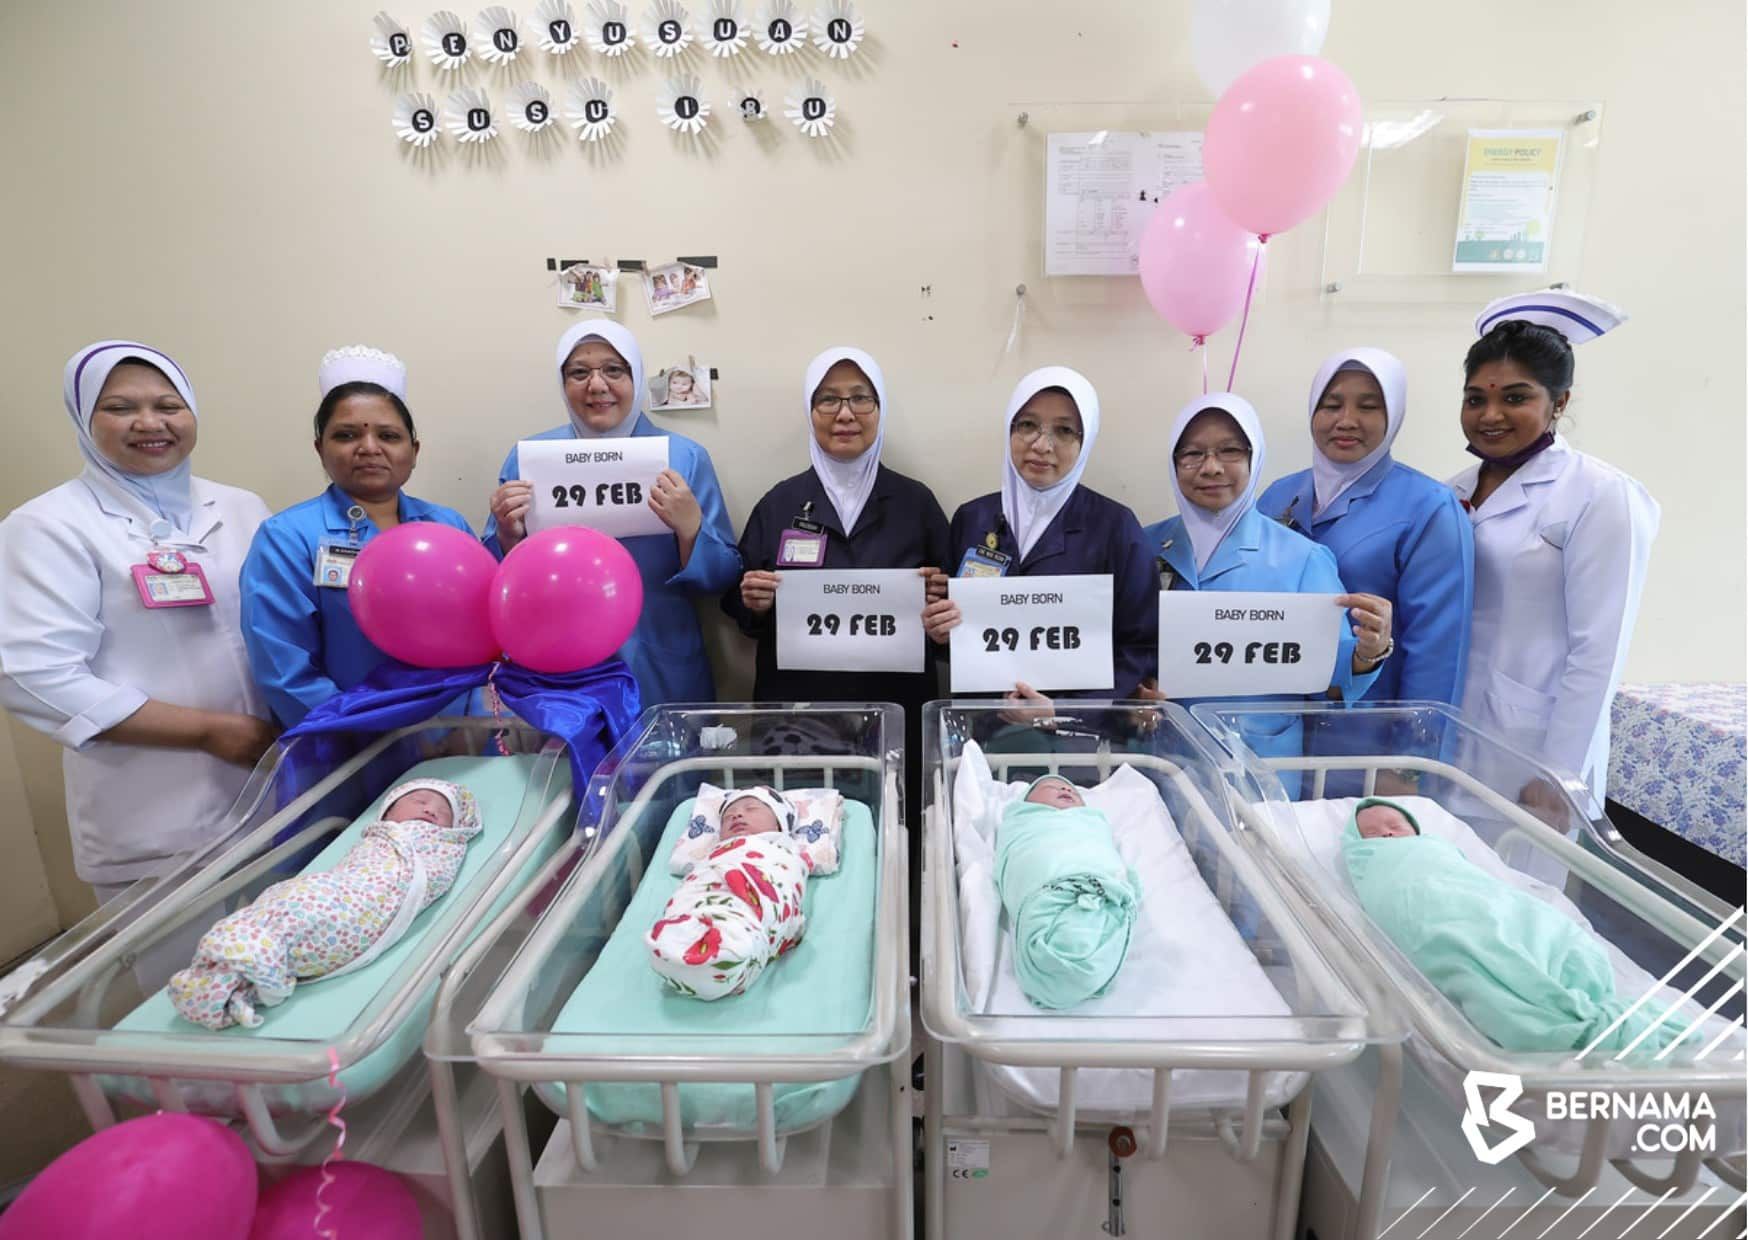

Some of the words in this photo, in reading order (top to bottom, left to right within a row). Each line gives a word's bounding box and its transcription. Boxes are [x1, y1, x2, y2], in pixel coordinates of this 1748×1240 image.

[392, 17, 850, 54] PENYUSUAN
[415, 101, 606, 128] SUSU
[565, 453, 591, 464] BABY
[594, 451, 623, 462] BORN
[552, 484, 586, 508] 29
[595, 482, 643, 506] FEB
[823, 584, 849, 594] BABY
[852, 584, 880, 594] BORN
[1000, 594, 1029, 605] BABY
[1032, 593, 1063, 604] BORN
[806, 613, 841, 636] 29
[849, 613, 896, 636] FEB
[1215, 609, 1247, 620] BABY
[1250, 609, 1285, 621] BORN
[982, 627, 1020, 652] 29
[1030, 626, 1081, 651] FEB
[1193, 641, 1234, 664] 29
[1244, 641, 1302, 664] FEB
